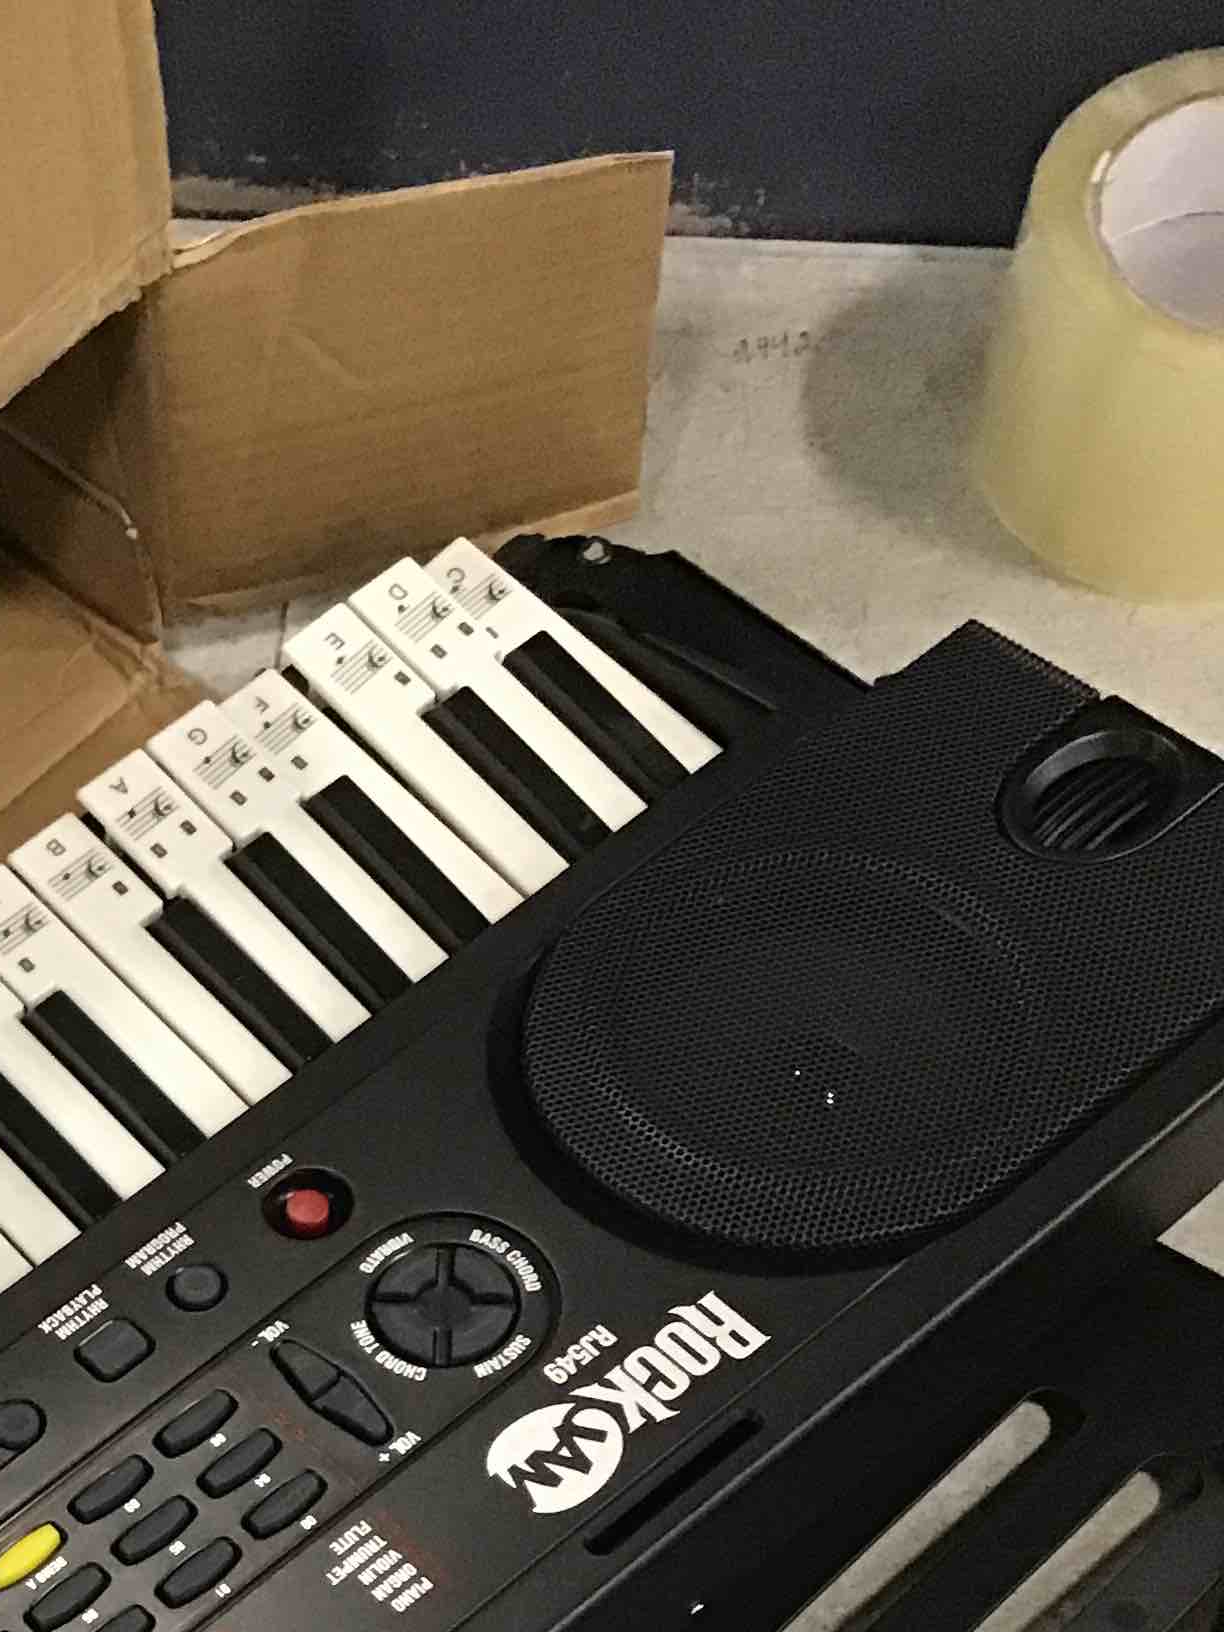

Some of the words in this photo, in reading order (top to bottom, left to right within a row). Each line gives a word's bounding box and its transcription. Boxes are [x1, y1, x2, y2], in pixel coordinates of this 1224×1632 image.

[124, 1221, 187, 1269] PROGRAM
[140, 1234, 195, 1276] RHYTHM
[359, 1232, 415, 1274] VIBRATO
[505, 1249, 542, 1292] CHORD
[37, 1283, 103, 1334] PLAYBACK
[54, 1297, 109, 1340] RHYTHM
[257, 1320, 290, 1343] VOL
[350, 1319, 380, 1355] TONE
[374, 1350, 428, 1381] CHORD
[473, 1334, 532, 1378] SUSTAIN
[543, 1324, 618, 1385] RJ549
[387, 1431, 422, 1455] VOL
[328, 1520, 372, 1556] FLUTE
[325, 1535, 388, 1586] TRUMPET
[357, 1549, 403, 1586] VIOLIN
[370, 1562, 418, 1602] ORGAN
[390, 1576, 434, 1613] PIANO
